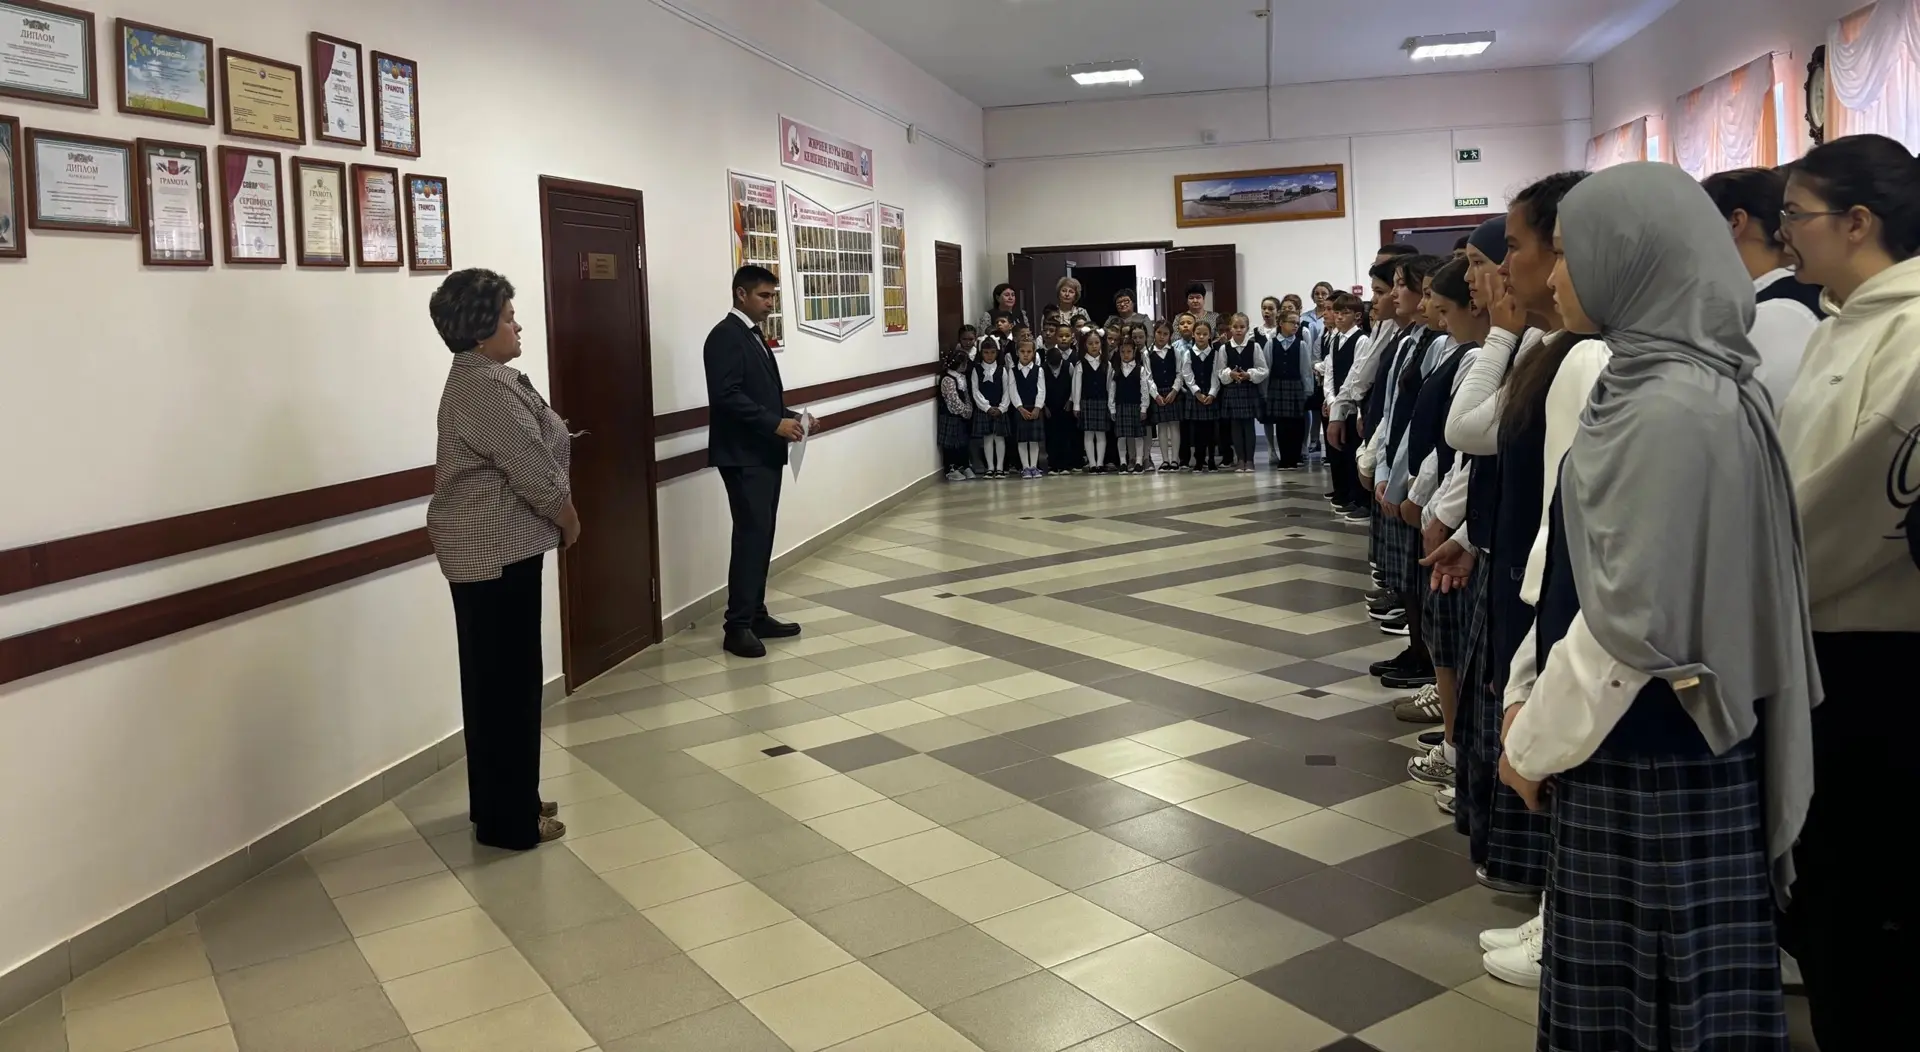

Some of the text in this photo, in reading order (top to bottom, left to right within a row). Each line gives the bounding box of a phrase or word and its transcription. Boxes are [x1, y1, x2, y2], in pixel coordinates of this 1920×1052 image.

[20, 29, 55, 43] ДИПЛОМ
[384, 83, 405, 95] ГРАМОТА
[65, 163, 99, 174] ДИПЛОМ
[160, 177, 189, 186] ГРАМОТА
[309, 189, 332, 199] ГРАМОТА
[418, 203, 436, 211] ГРАМОТА
[1457, 198, 1485, 206] ВЫХОД
